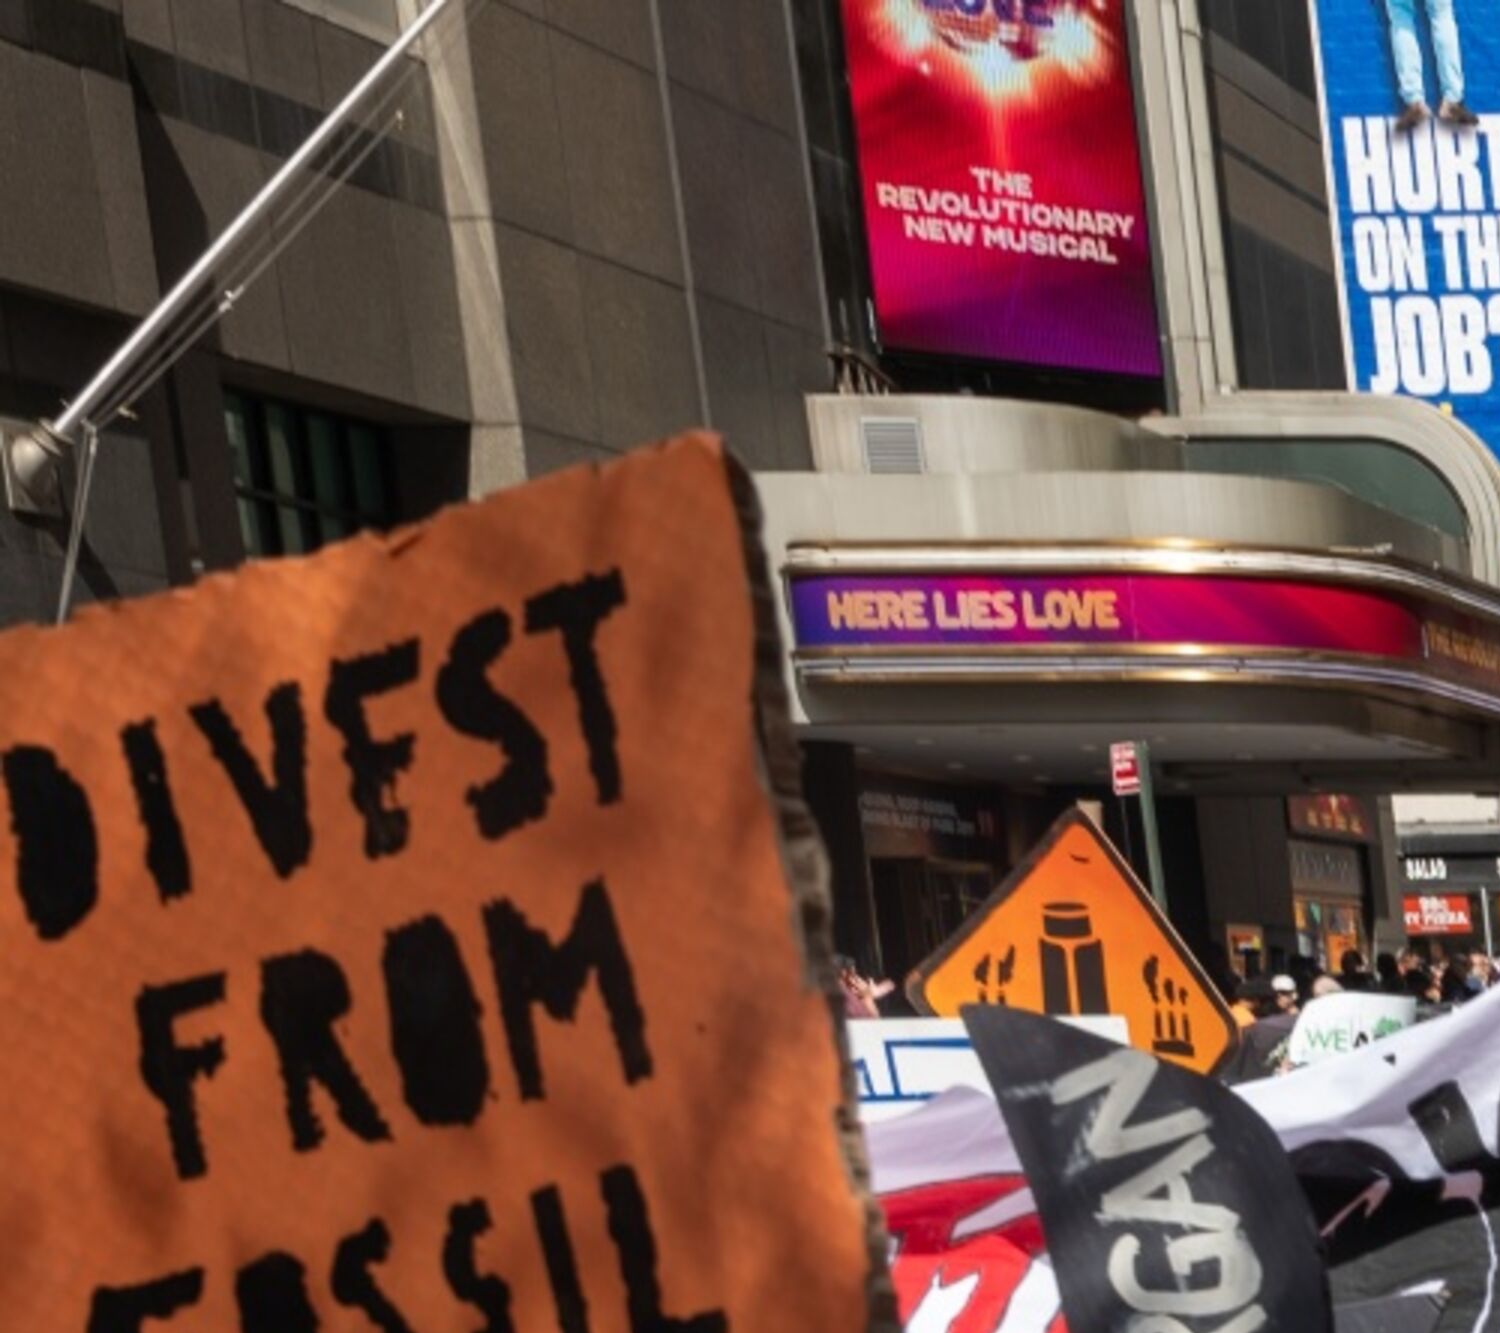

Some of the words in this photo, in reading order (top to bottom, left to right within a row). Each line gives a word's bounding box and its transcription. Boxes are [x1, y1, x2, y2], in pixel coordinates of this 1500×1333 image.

[876, 182, 1134, 240] REVOLUTIONARY
[970, 166, 1031, 199] THE
[904, 215, 975, 246] NEW
[982, 226, 1117, 264] MUSICAL
[1353, 216, 1428, 293] ON
[827, 591, 929, 630] HERE
[933, 590, 1017, 629] LIES
[1022, 590, 1120, 629] LOVE
[2, 570, 629, 943] DIVEST
[134, 876, 654, 1181] FROM
